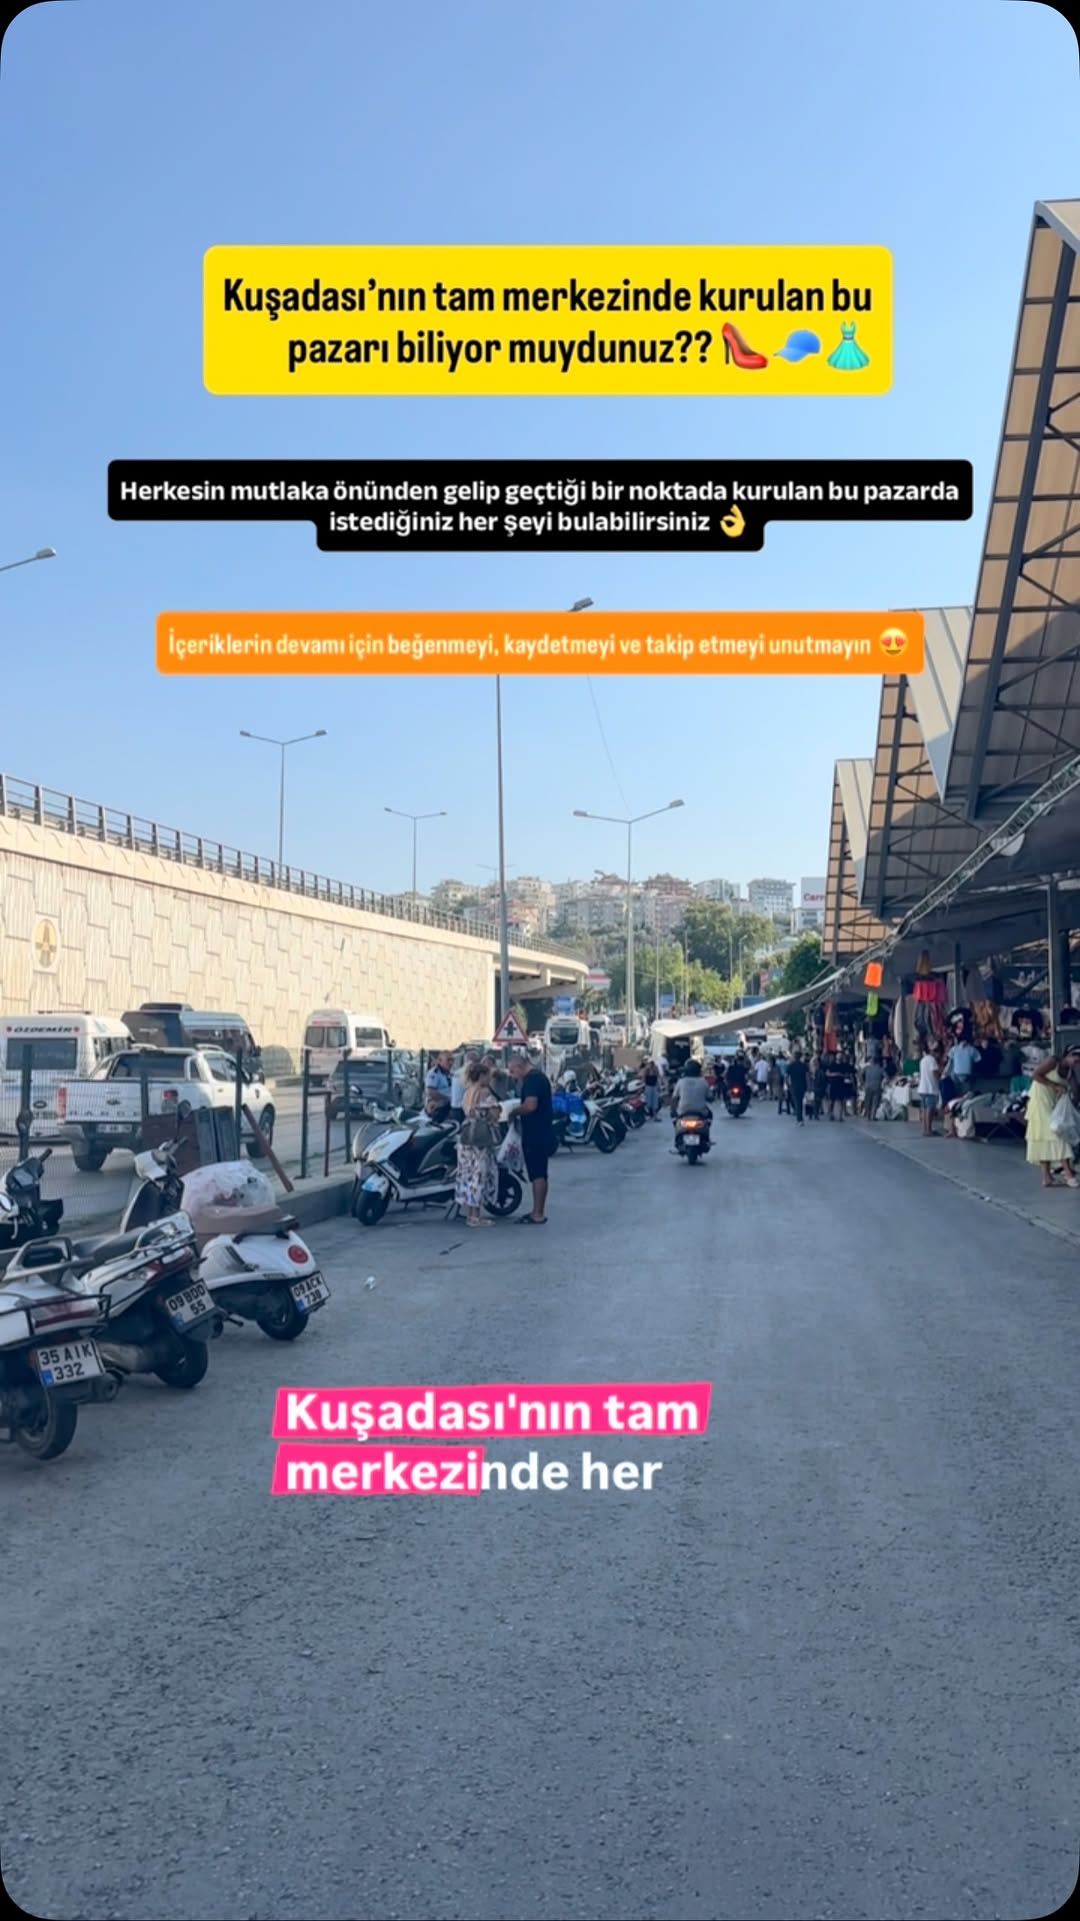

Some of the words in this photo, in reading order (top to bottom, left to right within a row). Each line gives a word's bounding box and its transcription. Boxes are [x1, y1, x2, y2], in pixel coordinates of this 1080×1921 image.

[40, 1349, 60, 1366] 35
[64, 1343, 93, 1361] AIK
[53, 1362, 85, 1381] 332
